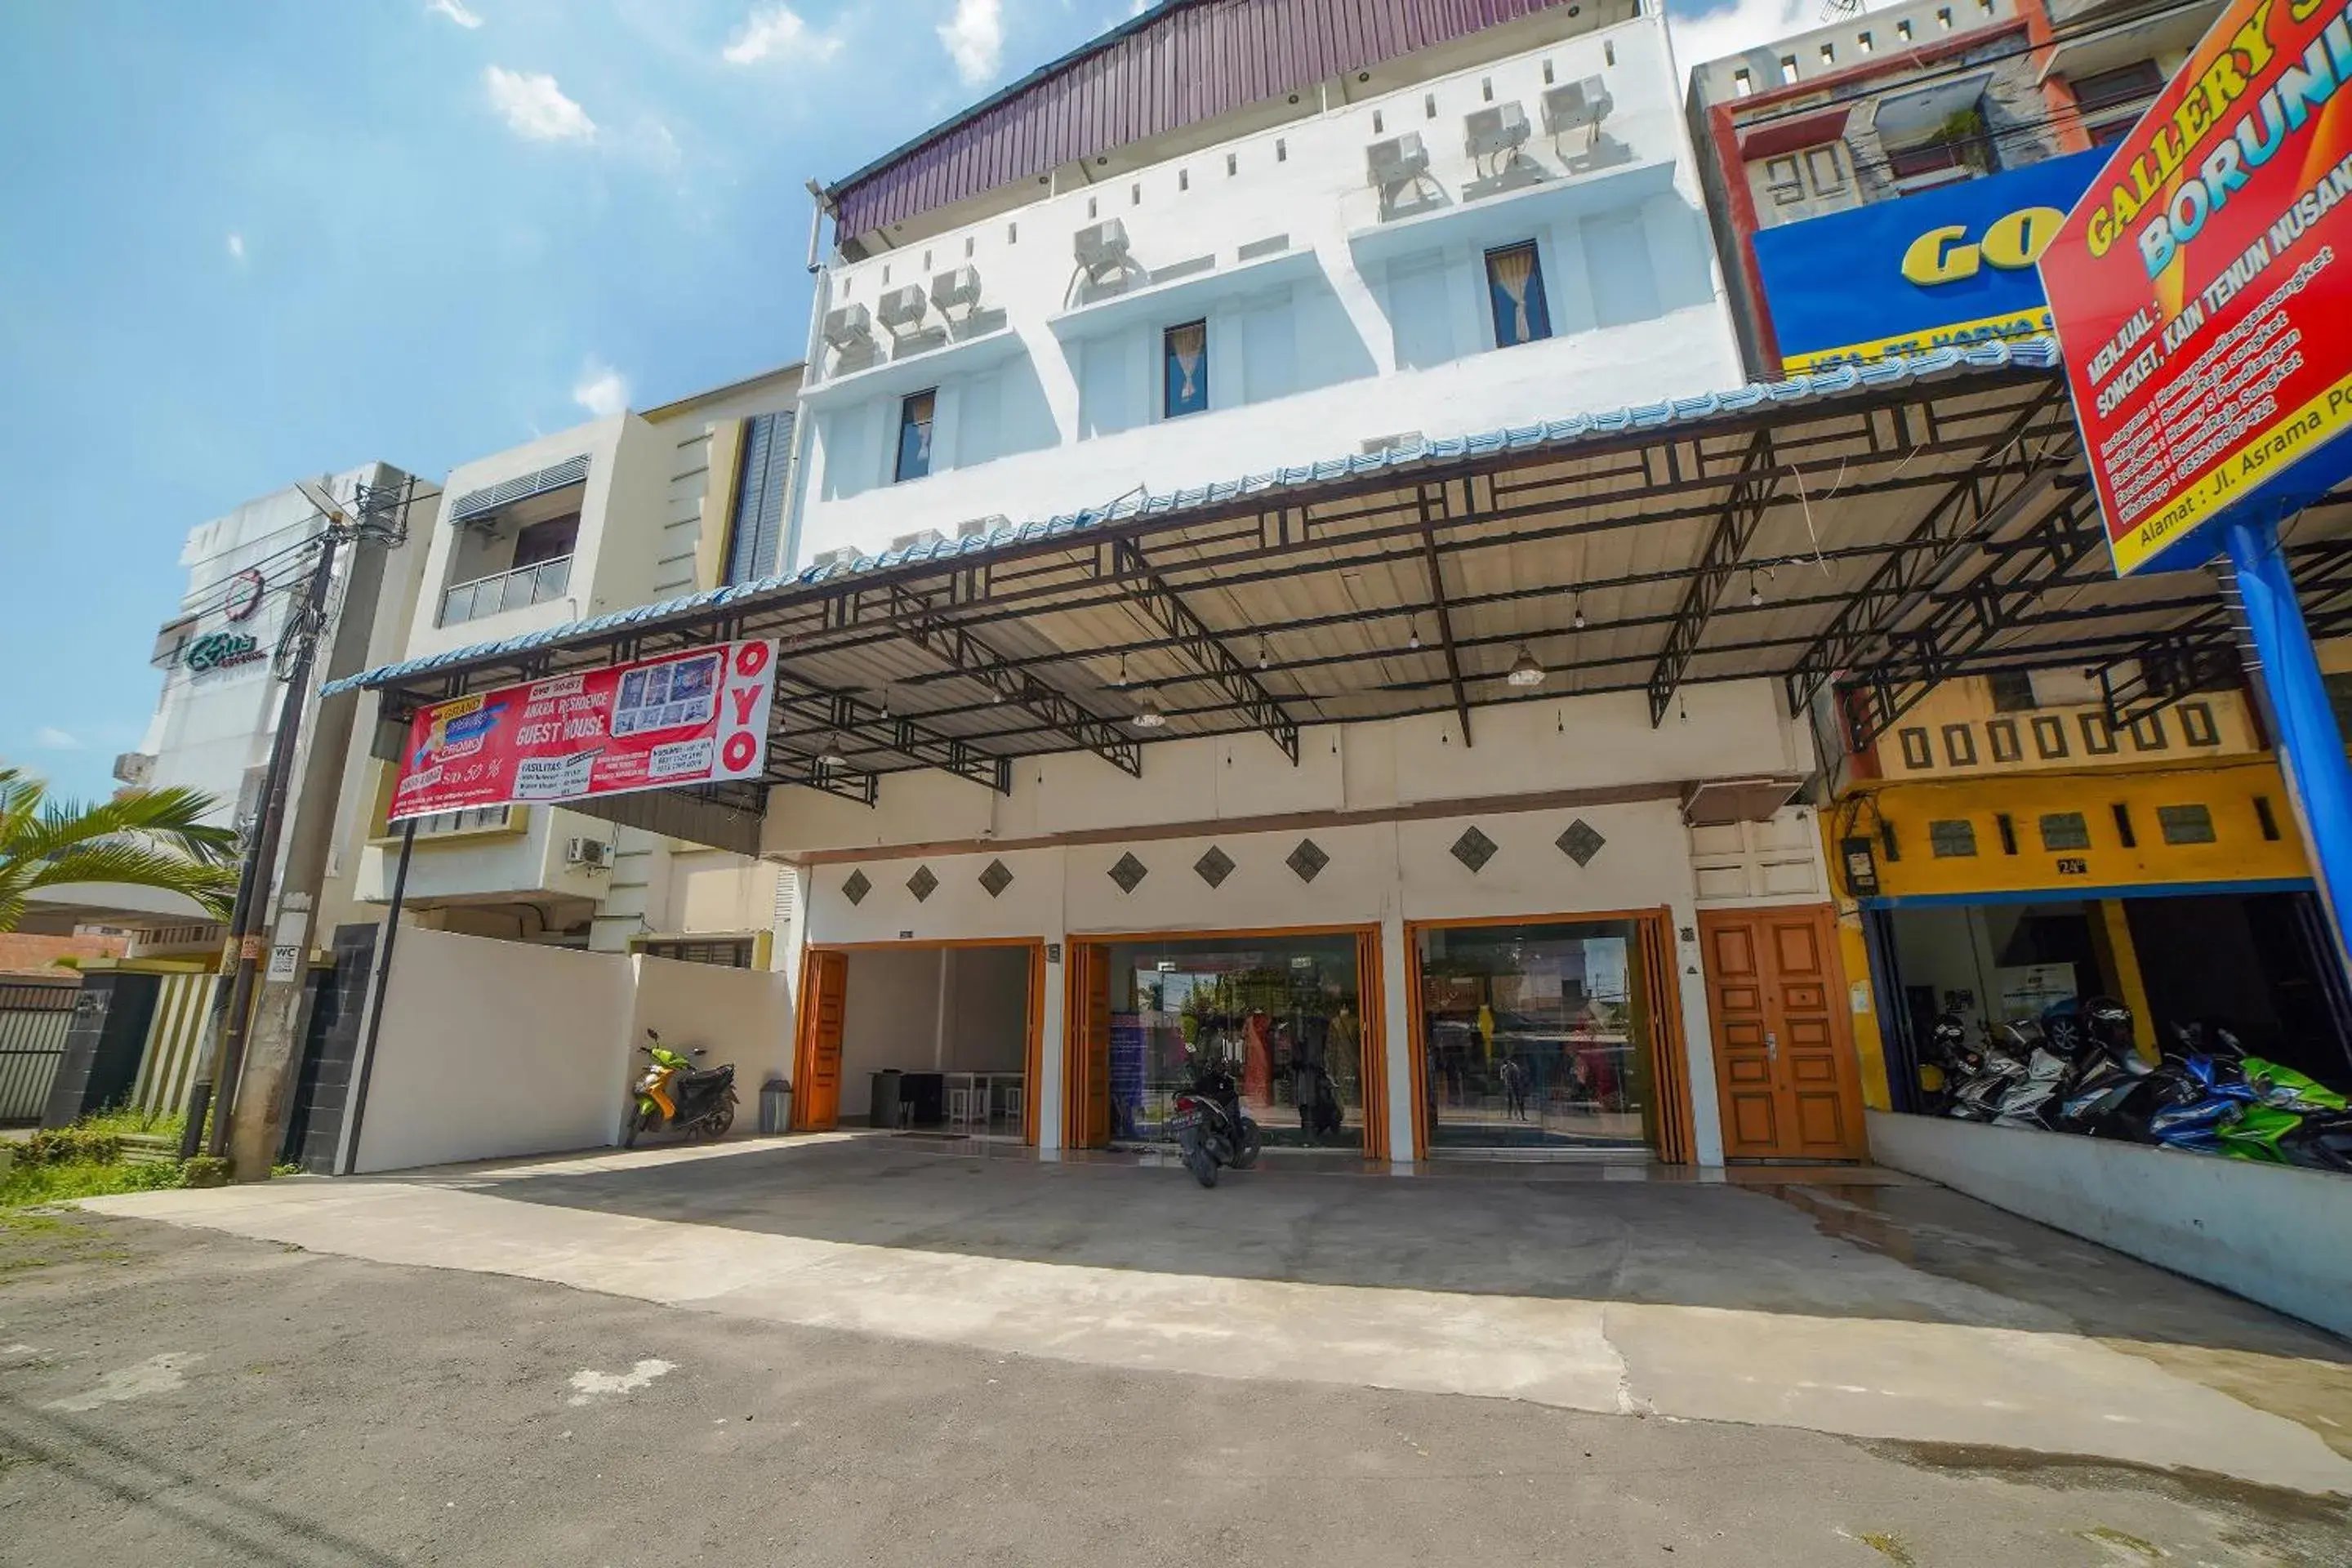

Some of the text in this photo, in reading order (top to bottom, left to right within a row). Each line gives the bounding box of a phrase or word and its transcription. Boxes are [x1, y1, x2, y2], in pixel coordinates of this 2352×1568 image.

[2087, 0, 2275, 259] GALLERY
[2162, 299, 2205, 357] KAIN
[2201, 237, 2271, 315] TENUN
[2087, 308, 2154, 386] MENJUAL
[2228, 310, 2289, 366] songket
[2165, 403, 2205, 444] Henny
[2140, 494, 2195, 546] Alamat
[2241, 410, 2321, 475] Asrama
[516, 715, 604, 746] GUEST HOUSE
[723, 640, 769, 773] OYO
[276, 947, 296, 957] WC
